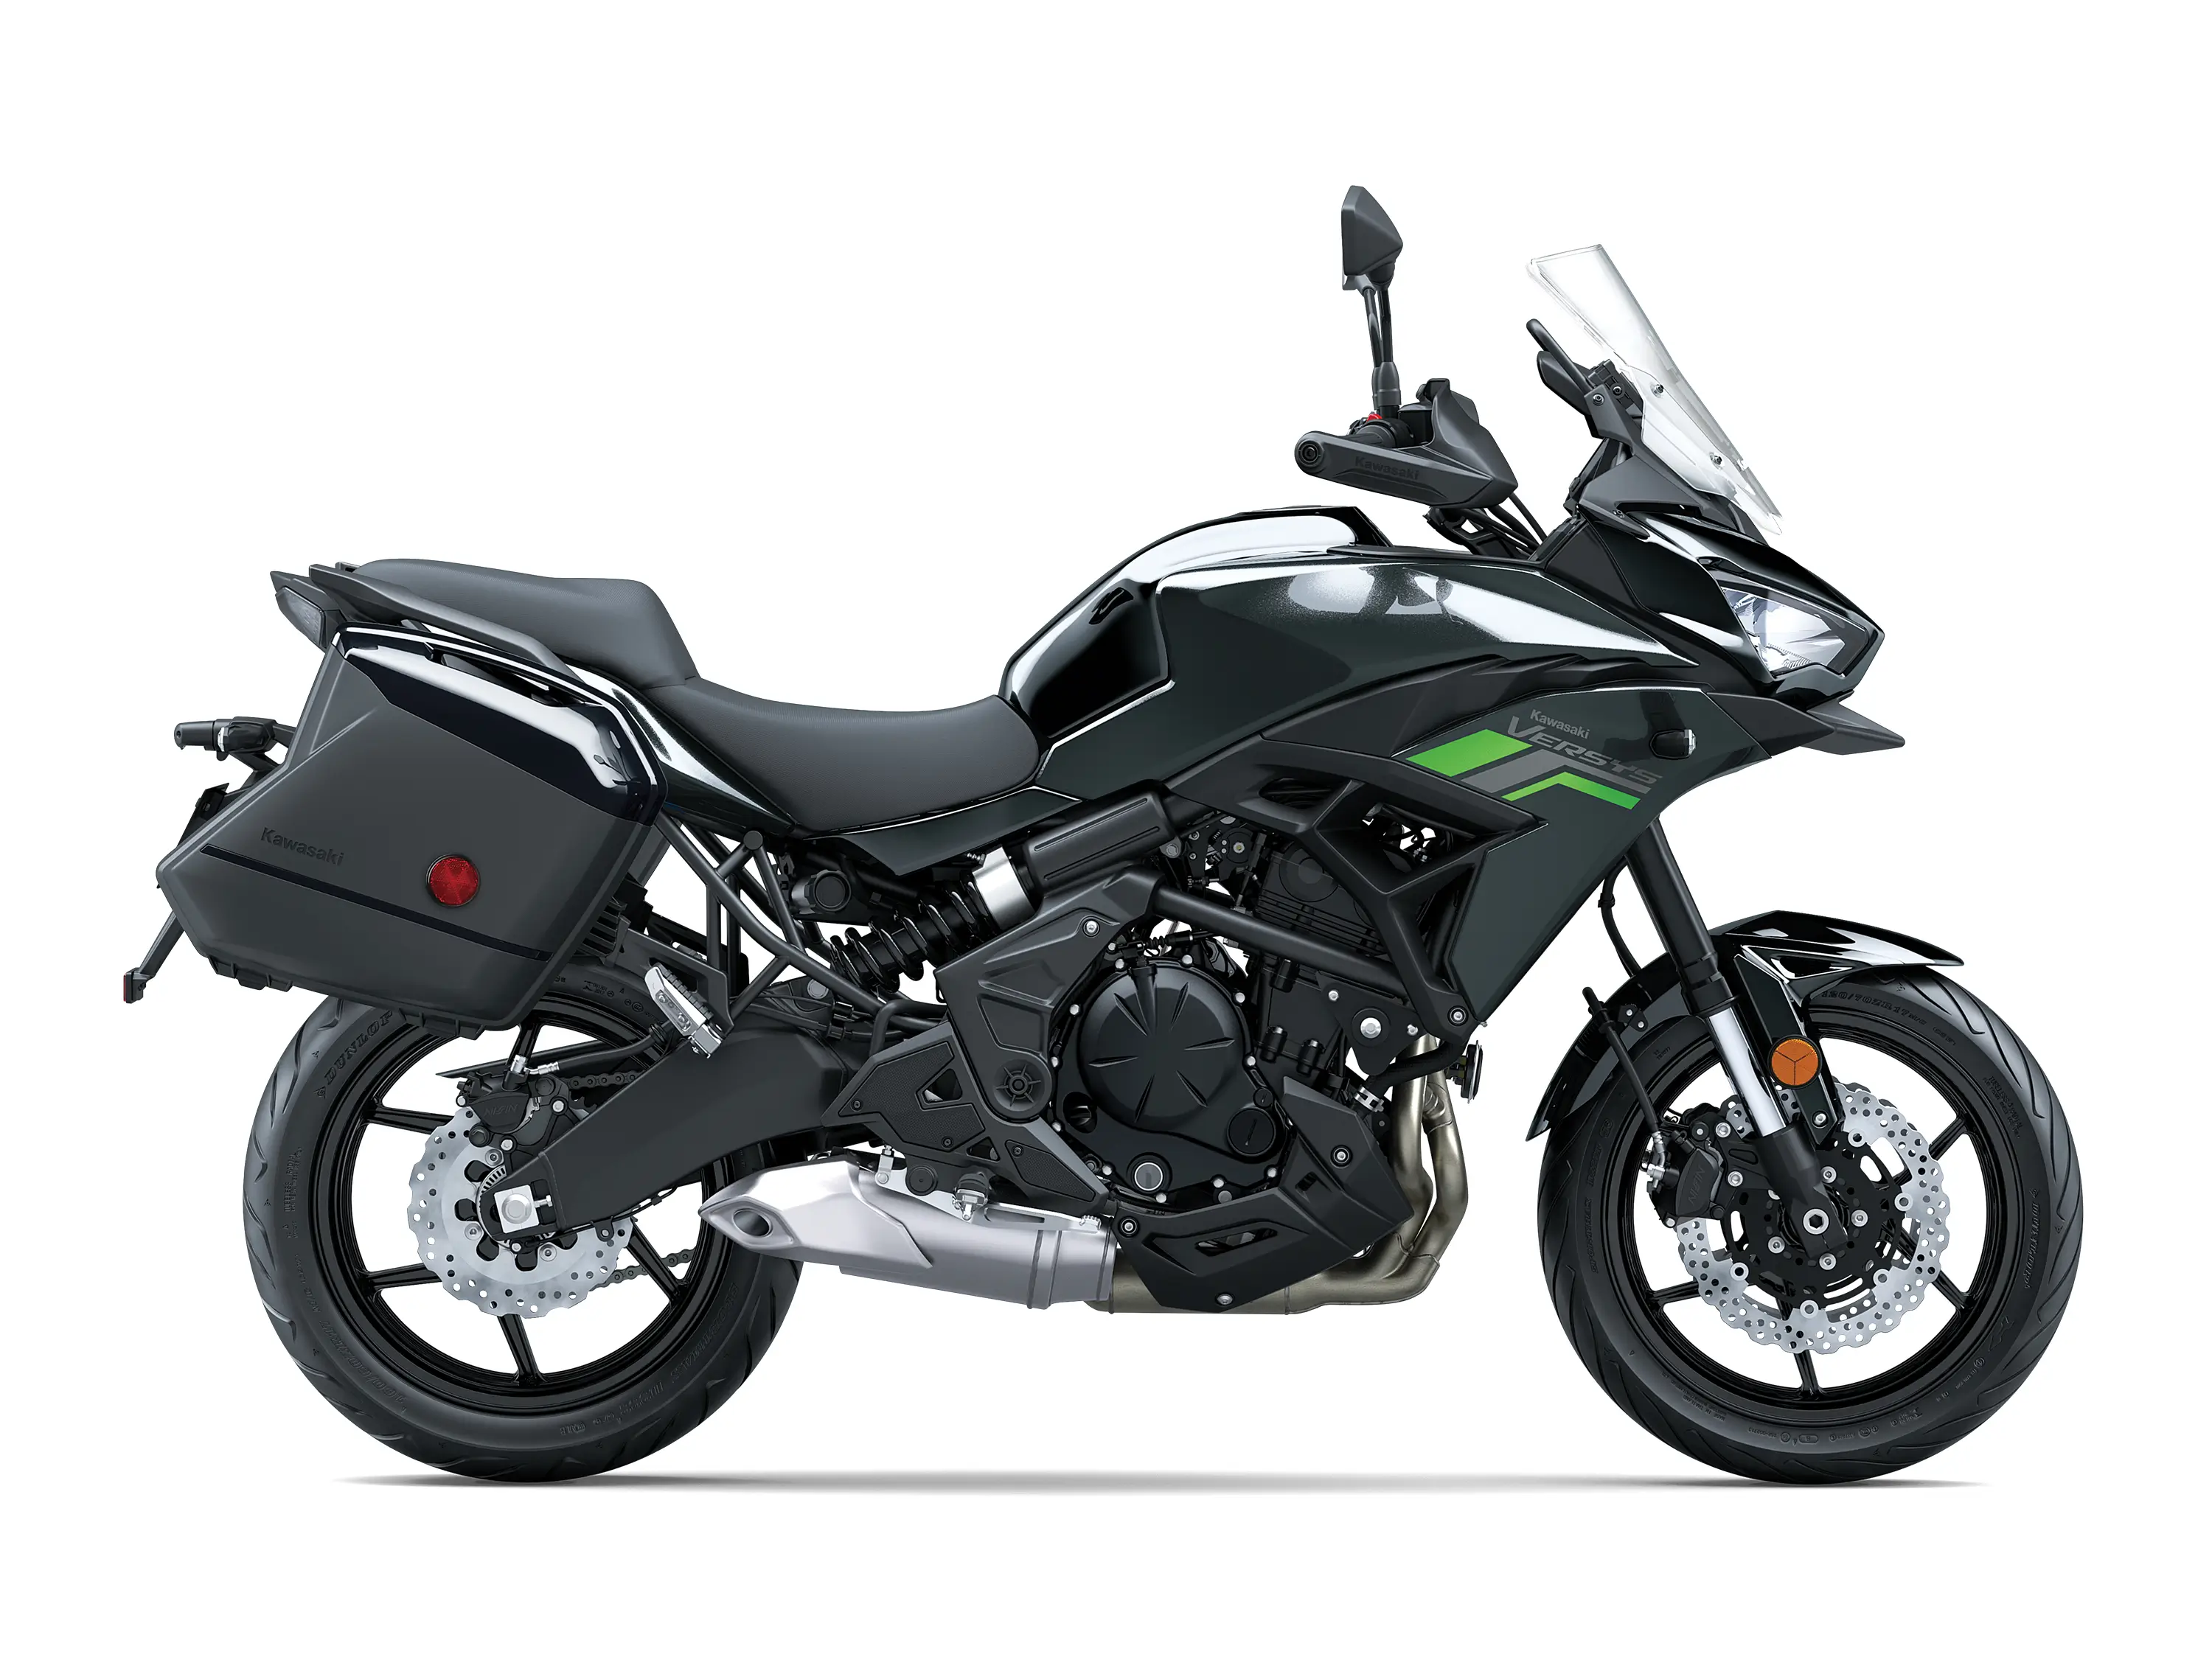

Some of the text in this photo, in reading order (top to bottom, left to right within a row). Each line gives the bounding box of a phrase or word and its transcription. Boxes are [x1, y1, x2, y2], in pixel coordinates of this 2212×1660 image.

[1355, 456, 1419, 480] Kawasaki
[1529, 708, 1590, 739] Kawasaki
[1507, 716, 1663, 785] VERSYS
[260, 826, 345, 866] Kawasaki
[324, 1008, 394, 1086] DUNLOP
